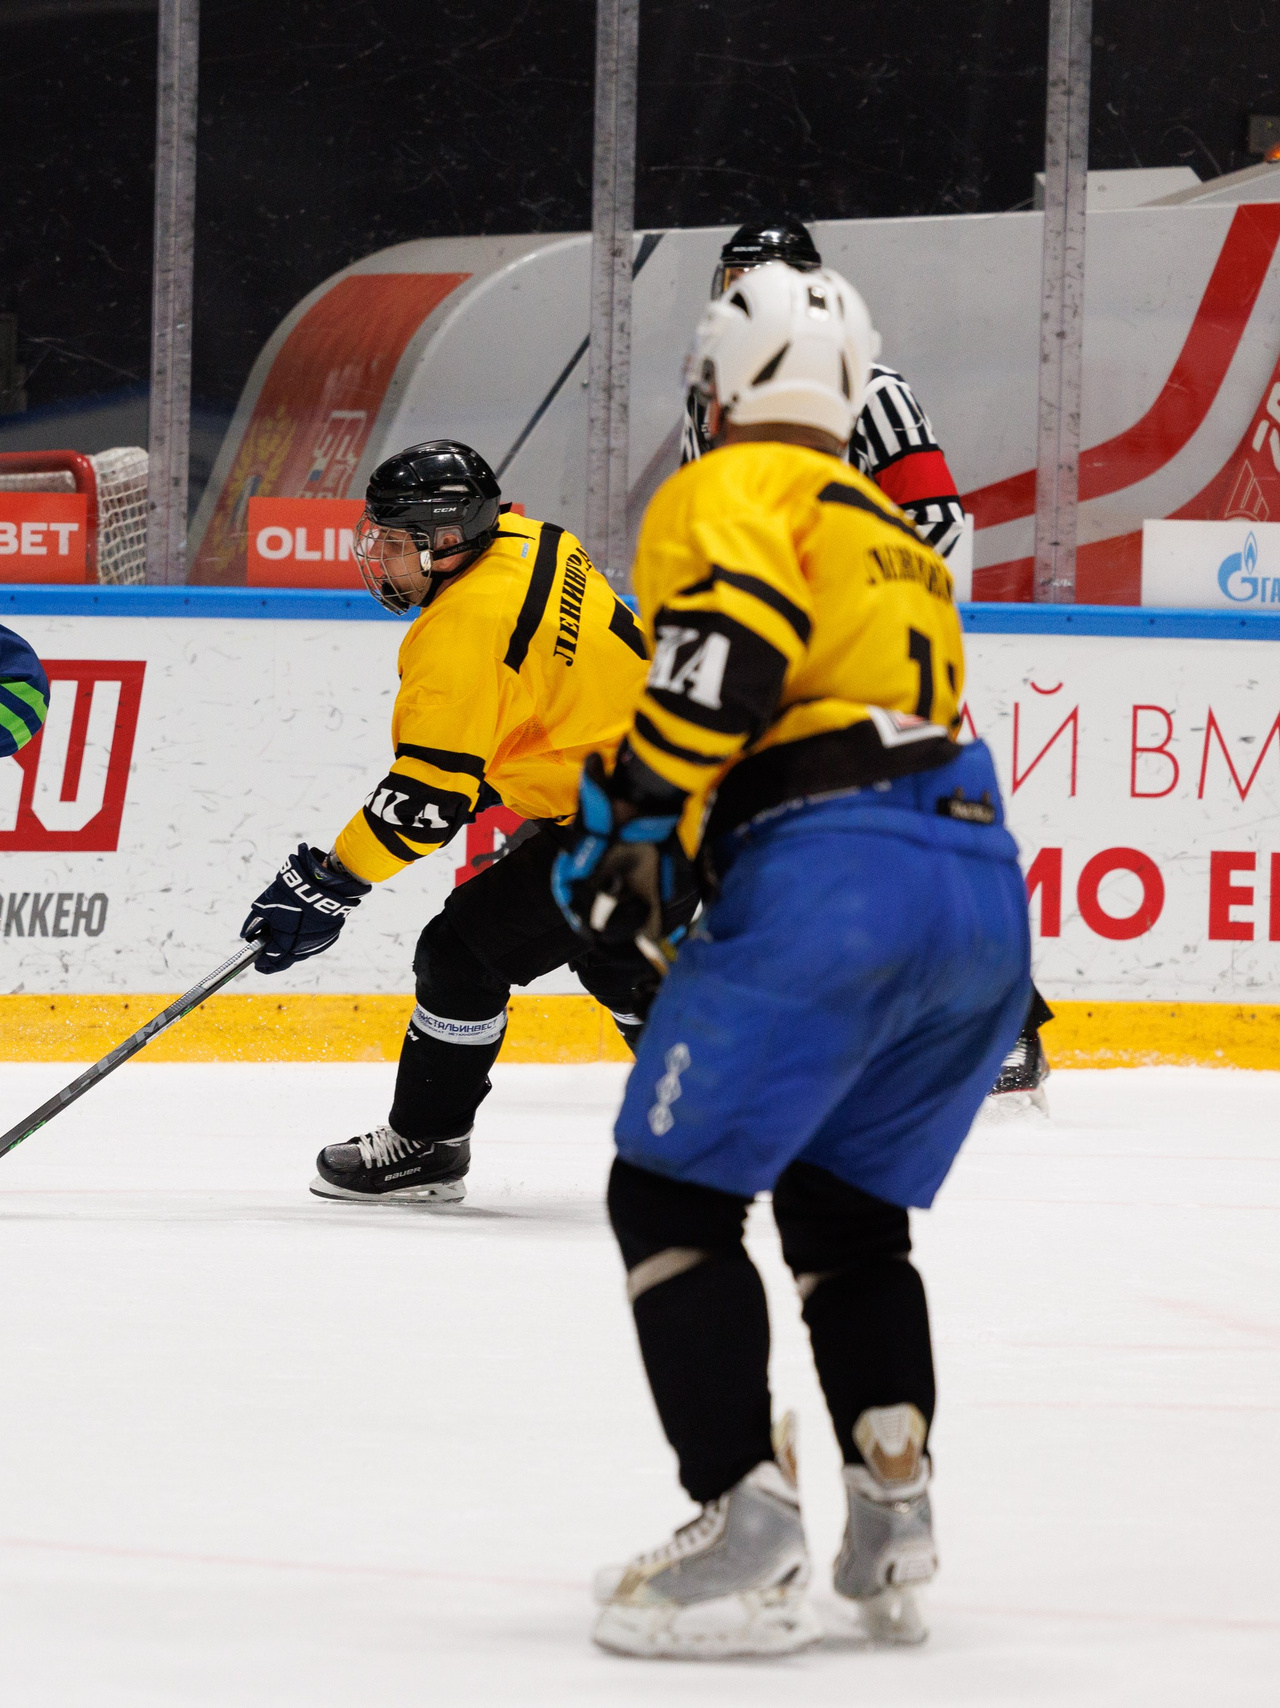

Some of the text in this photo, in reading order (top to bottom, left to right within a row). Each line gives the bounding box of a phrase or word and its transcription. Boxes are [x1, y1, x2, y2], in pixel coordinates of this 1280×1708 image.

[256, 526, 380, 562] OLIM
[1261, 577, 1280, 602] ГА
[1131, 704, 1280, 802] ВМ
